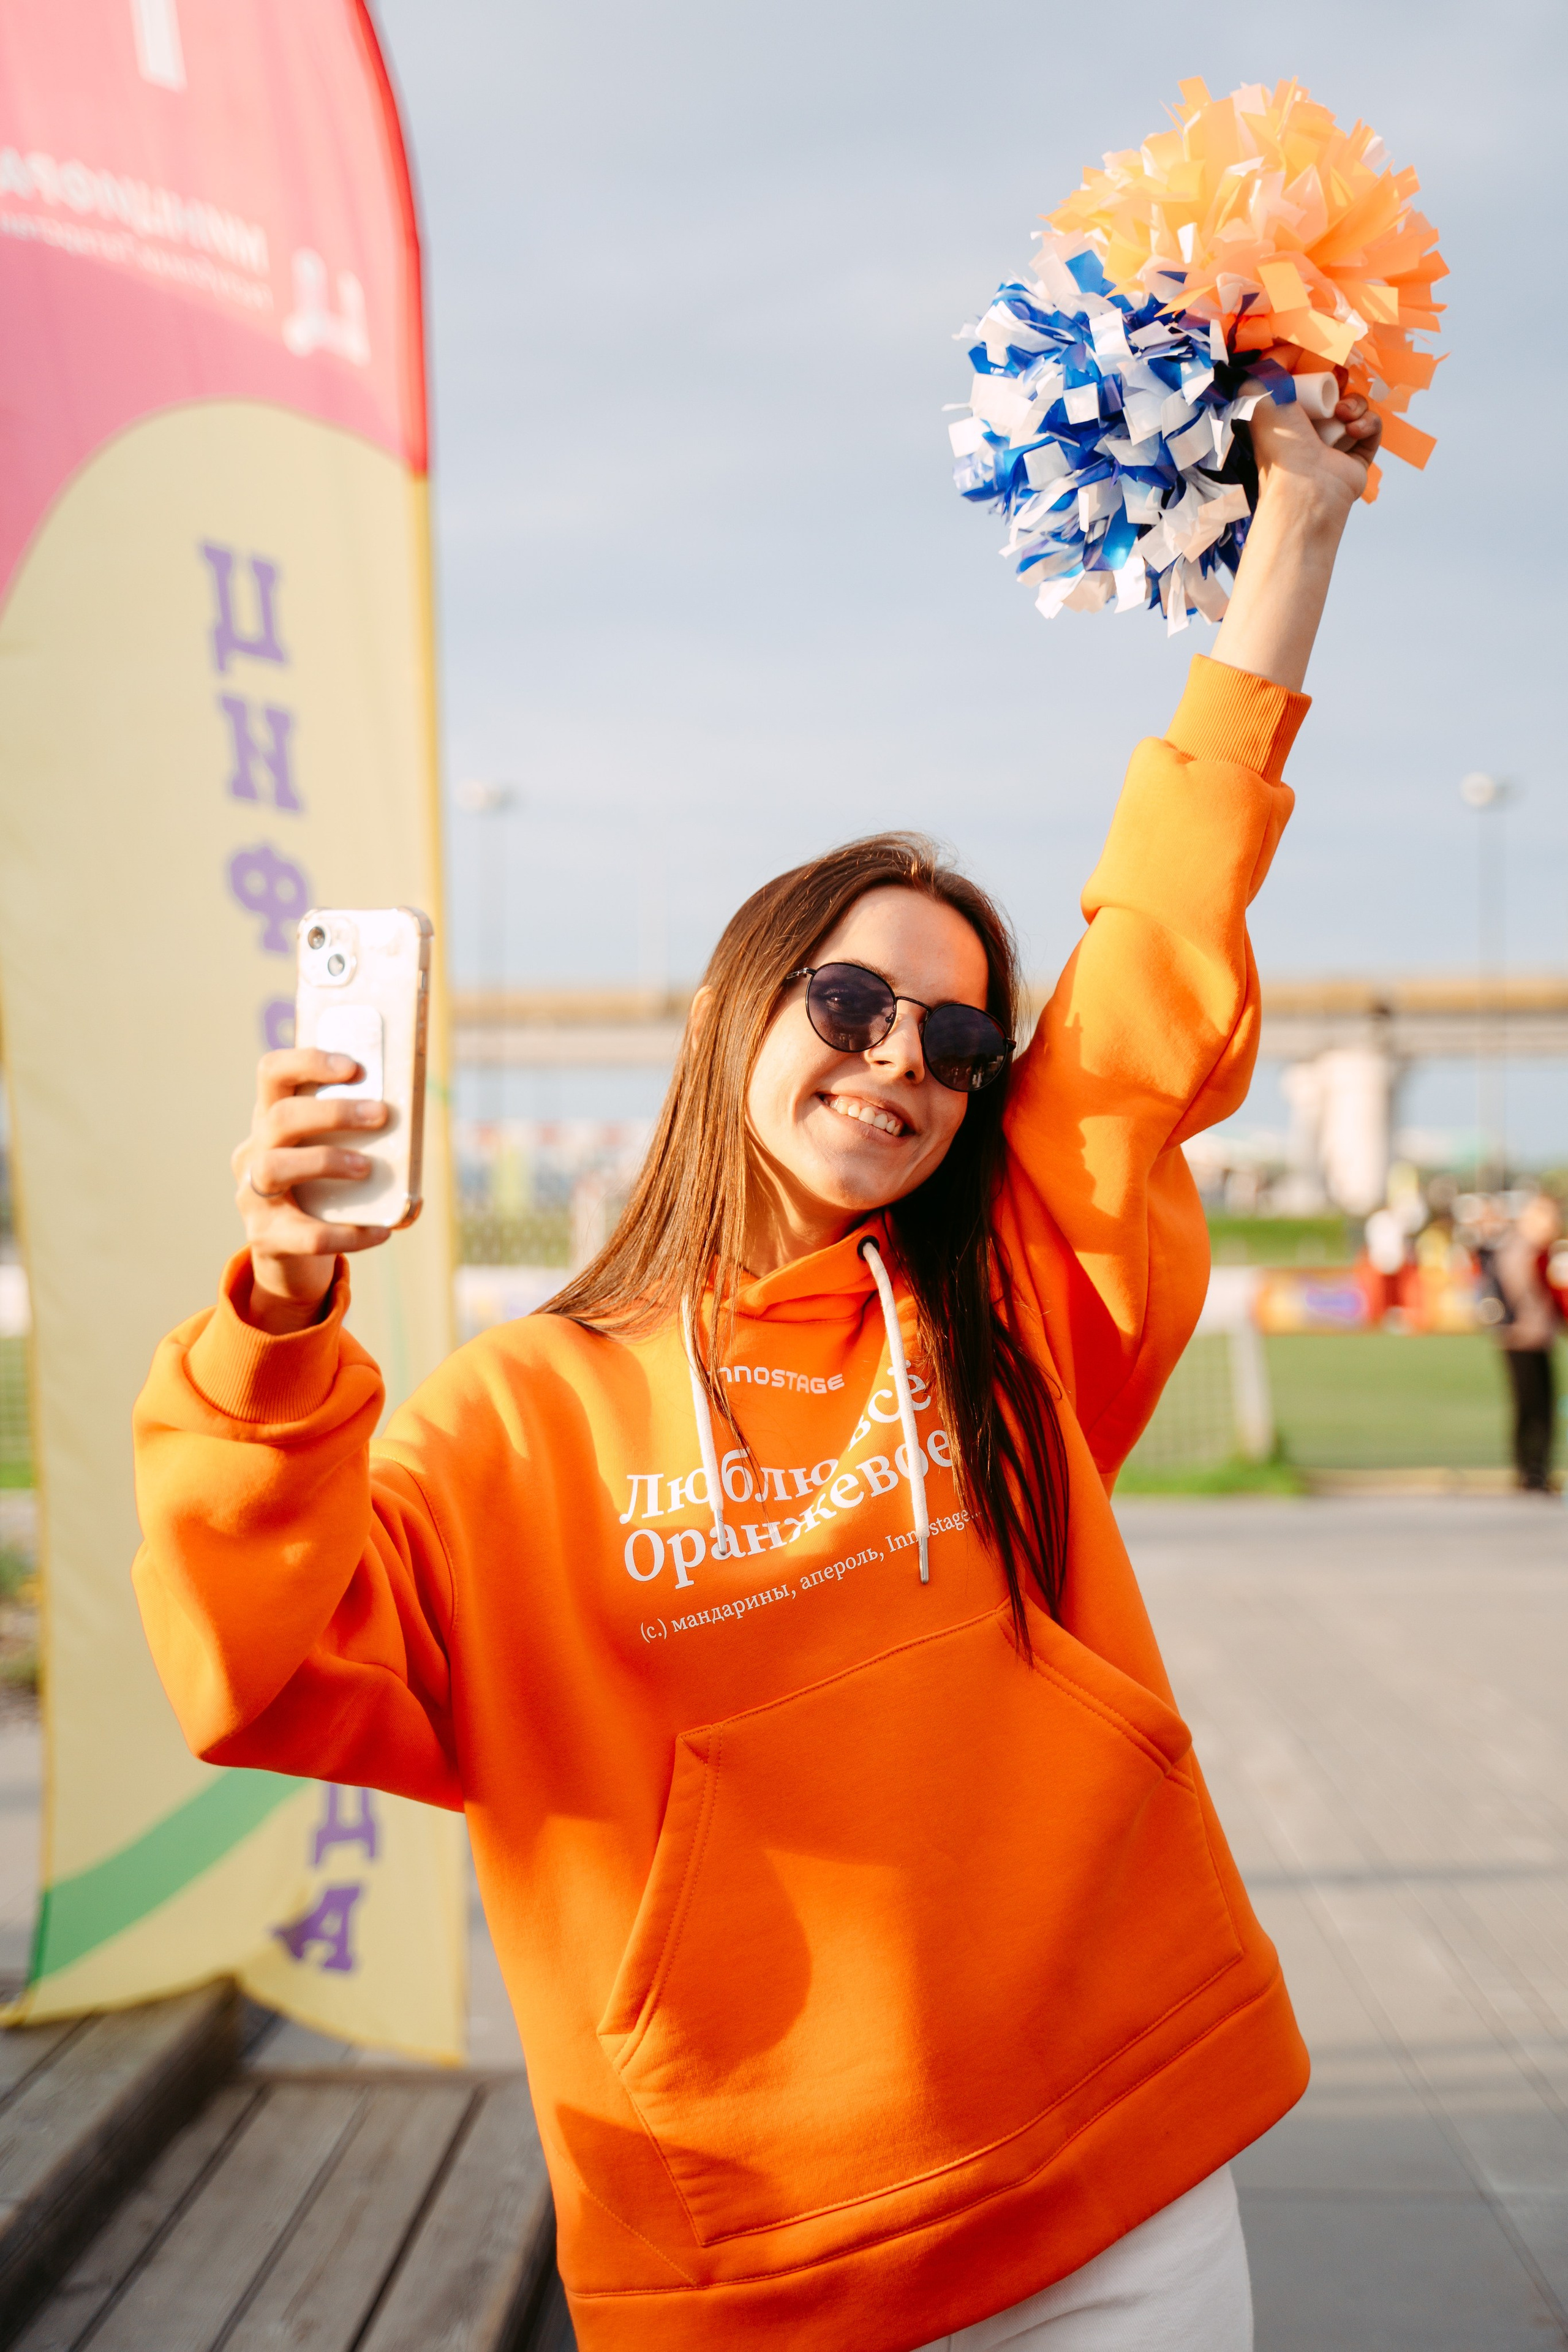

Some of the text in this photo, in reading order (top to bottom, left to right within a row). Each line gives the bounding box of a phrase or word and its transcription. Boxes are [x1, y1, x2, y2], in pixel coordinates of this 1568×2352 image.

[619, 1446, 839, 1524] Люблю
[624, 1429, 954, 1589] Оранжевое
[671, 1584, 796, 1632] мандарины,
[799, 1548, 884, 1590] апероль,
[884, 1509, 982, 1553] Innstage...
